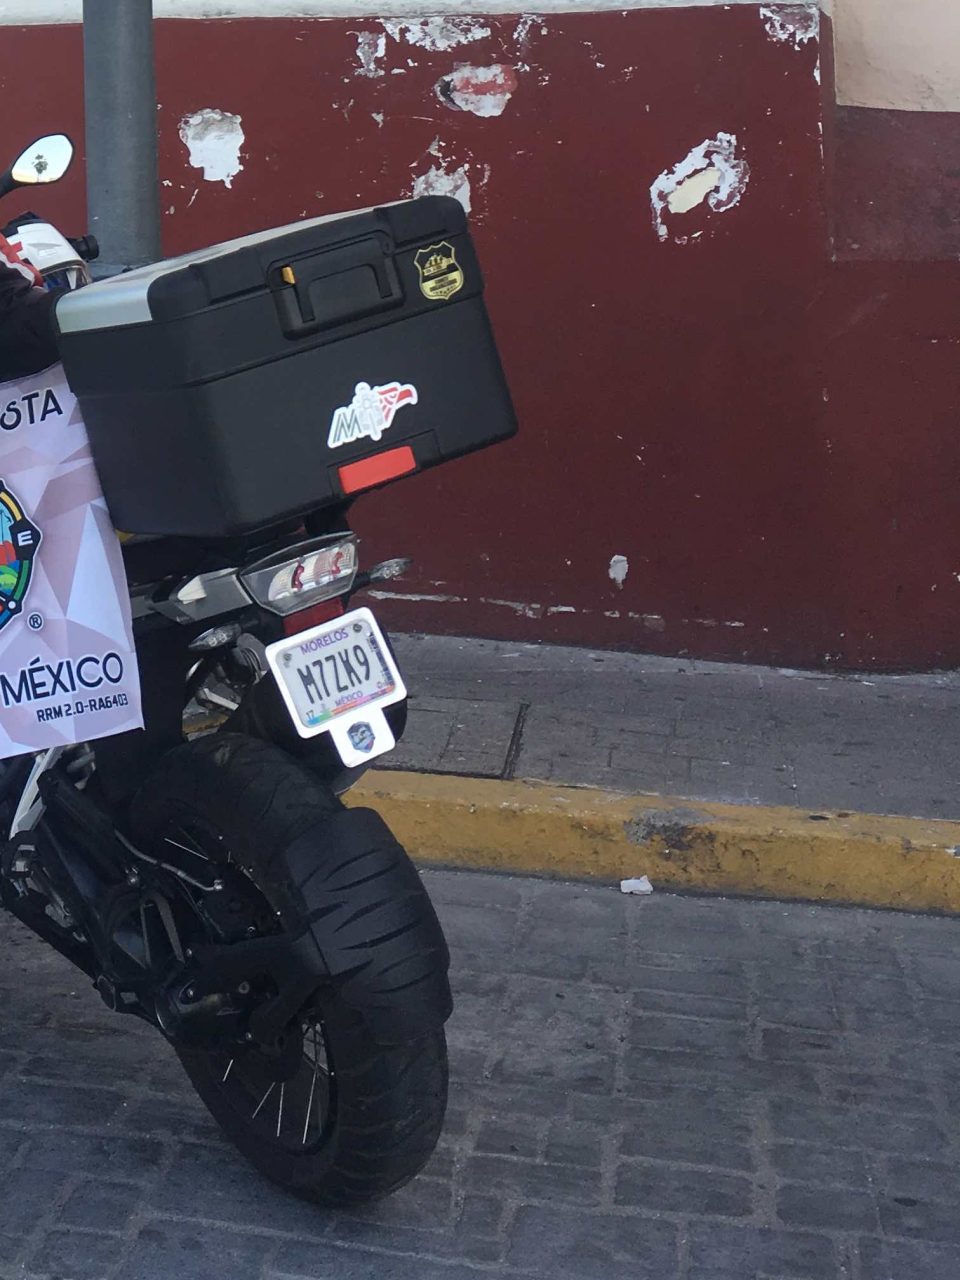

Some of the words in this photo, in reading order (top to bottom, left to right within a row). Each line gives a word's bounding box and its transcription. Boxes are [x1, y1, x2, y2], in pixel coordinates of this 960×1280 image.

[18, 531, 33, 546] E
[300, 629, 349, 655] MORELOS
[0, 652, 124, 706] MÉXICO
